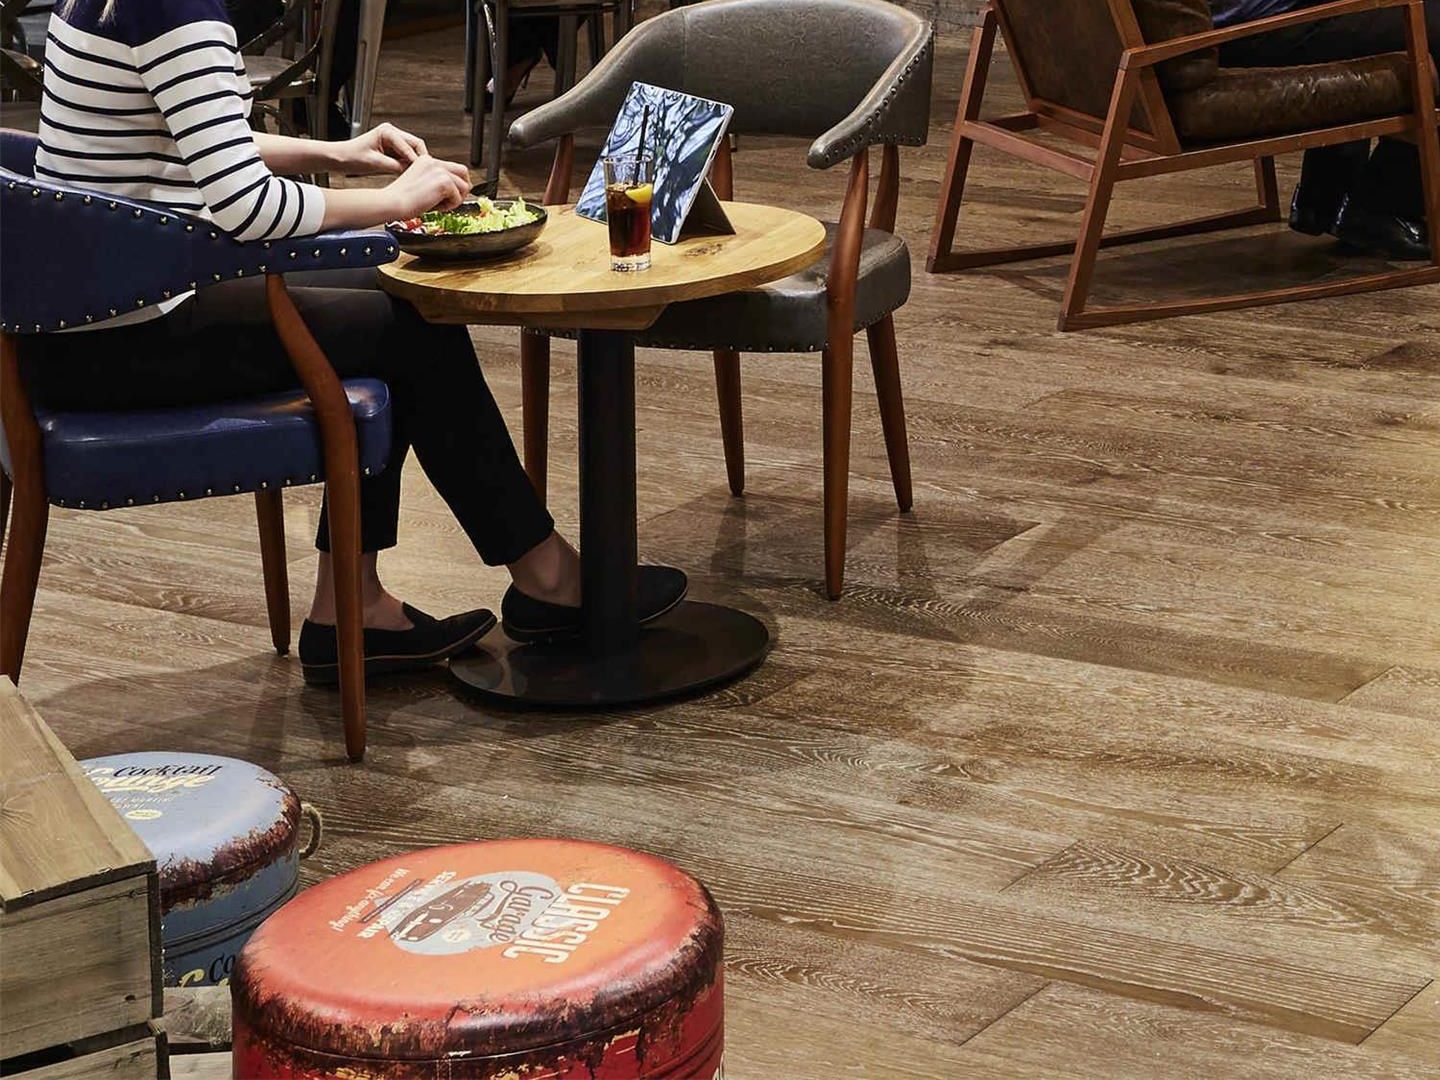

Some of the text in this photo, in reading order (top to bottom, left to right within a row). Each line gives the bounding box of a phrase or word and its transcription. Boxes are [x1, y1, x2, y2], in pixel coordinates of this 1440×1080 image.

[113, 764, 223, 777] Cocktail
[476, 880, 555, 942] Garage
[503, 882, 631, 963] CLASSIC
